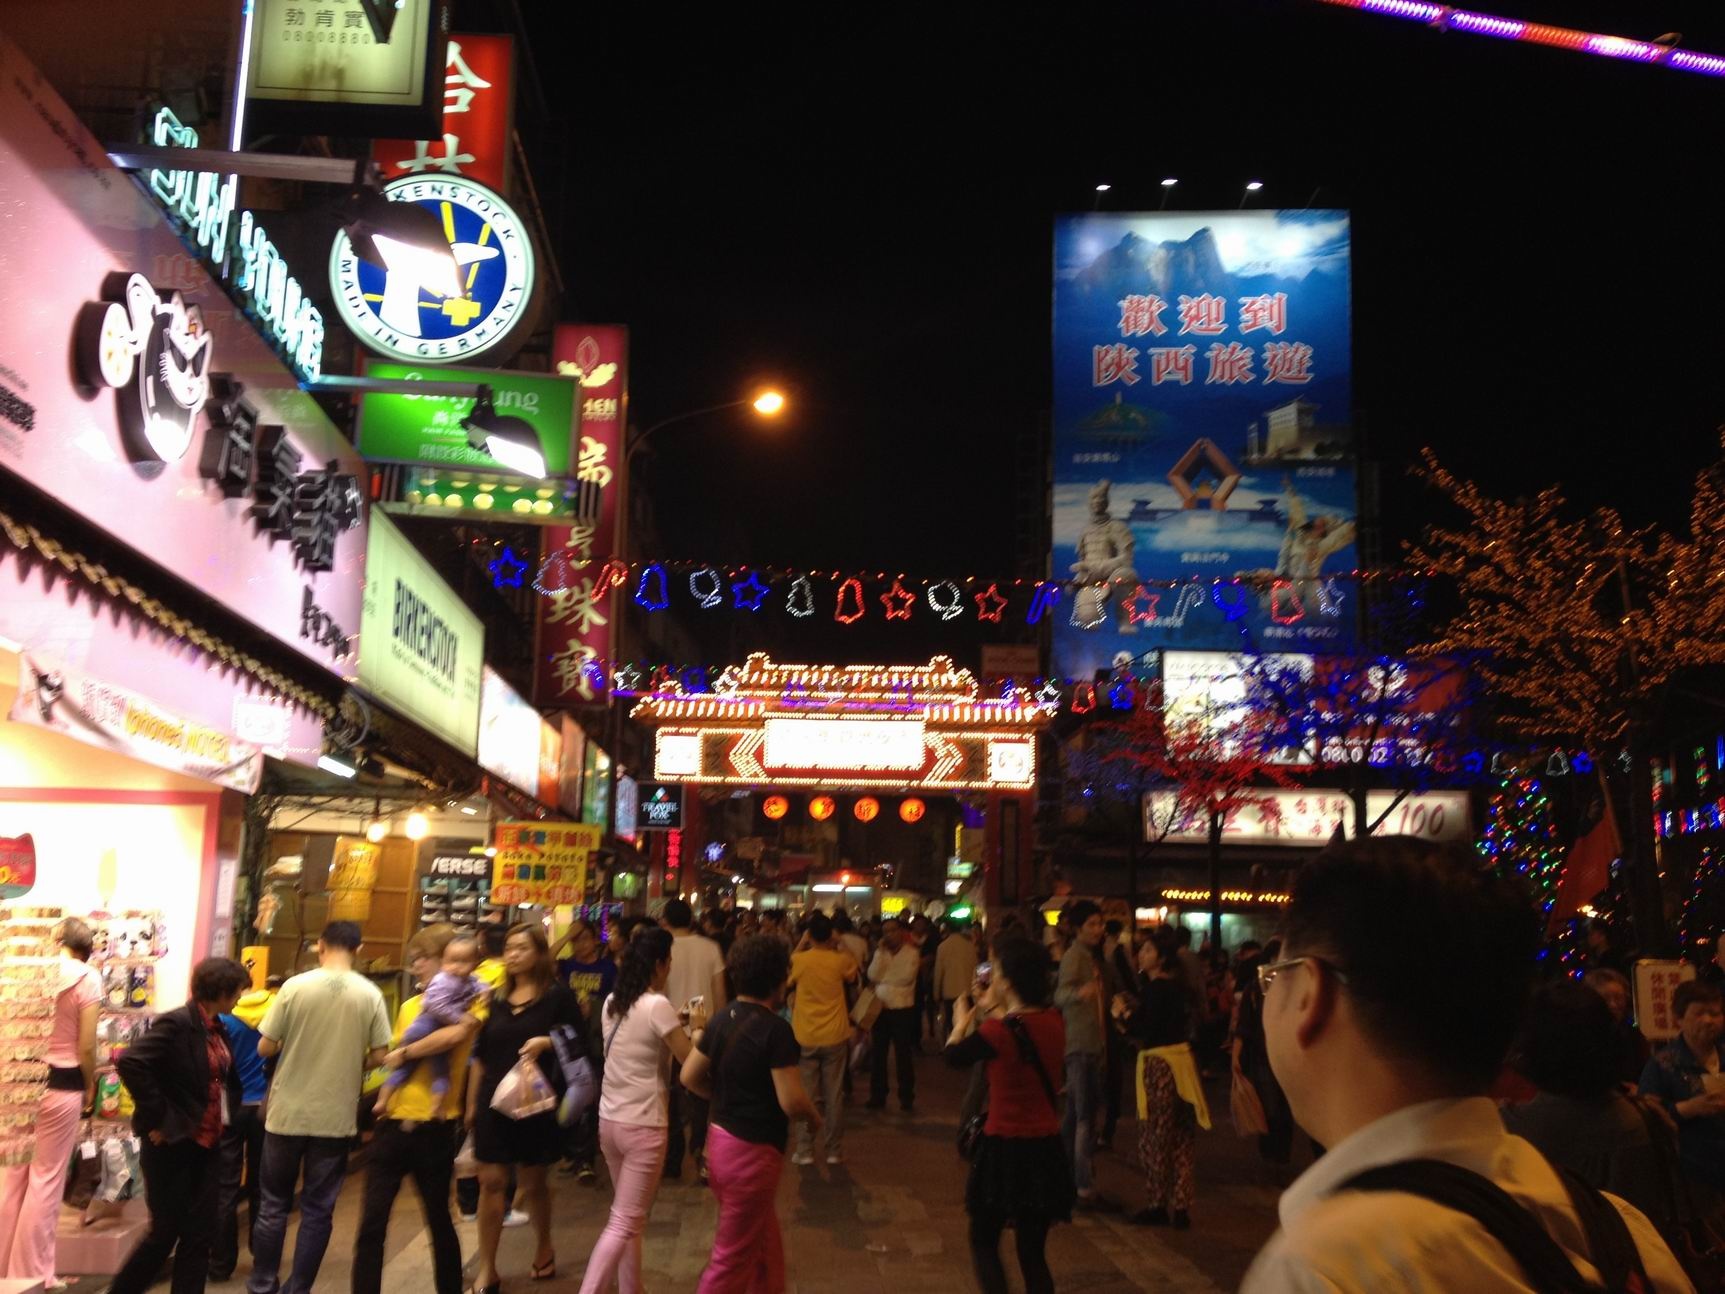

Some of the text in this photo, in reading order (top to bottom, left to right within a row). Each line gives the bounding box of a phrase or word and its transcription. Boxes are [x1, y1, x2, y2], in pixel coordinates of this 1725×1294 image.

[393, 182, 516, 240] KENSTOCK
[374, 327, 400, 347] IN
[417, 284, 523, 357] GERMANY
[1117, 292, 1289, 337] 歡迎到
[1092, 341, 1315, 387] 陝西旅遊
